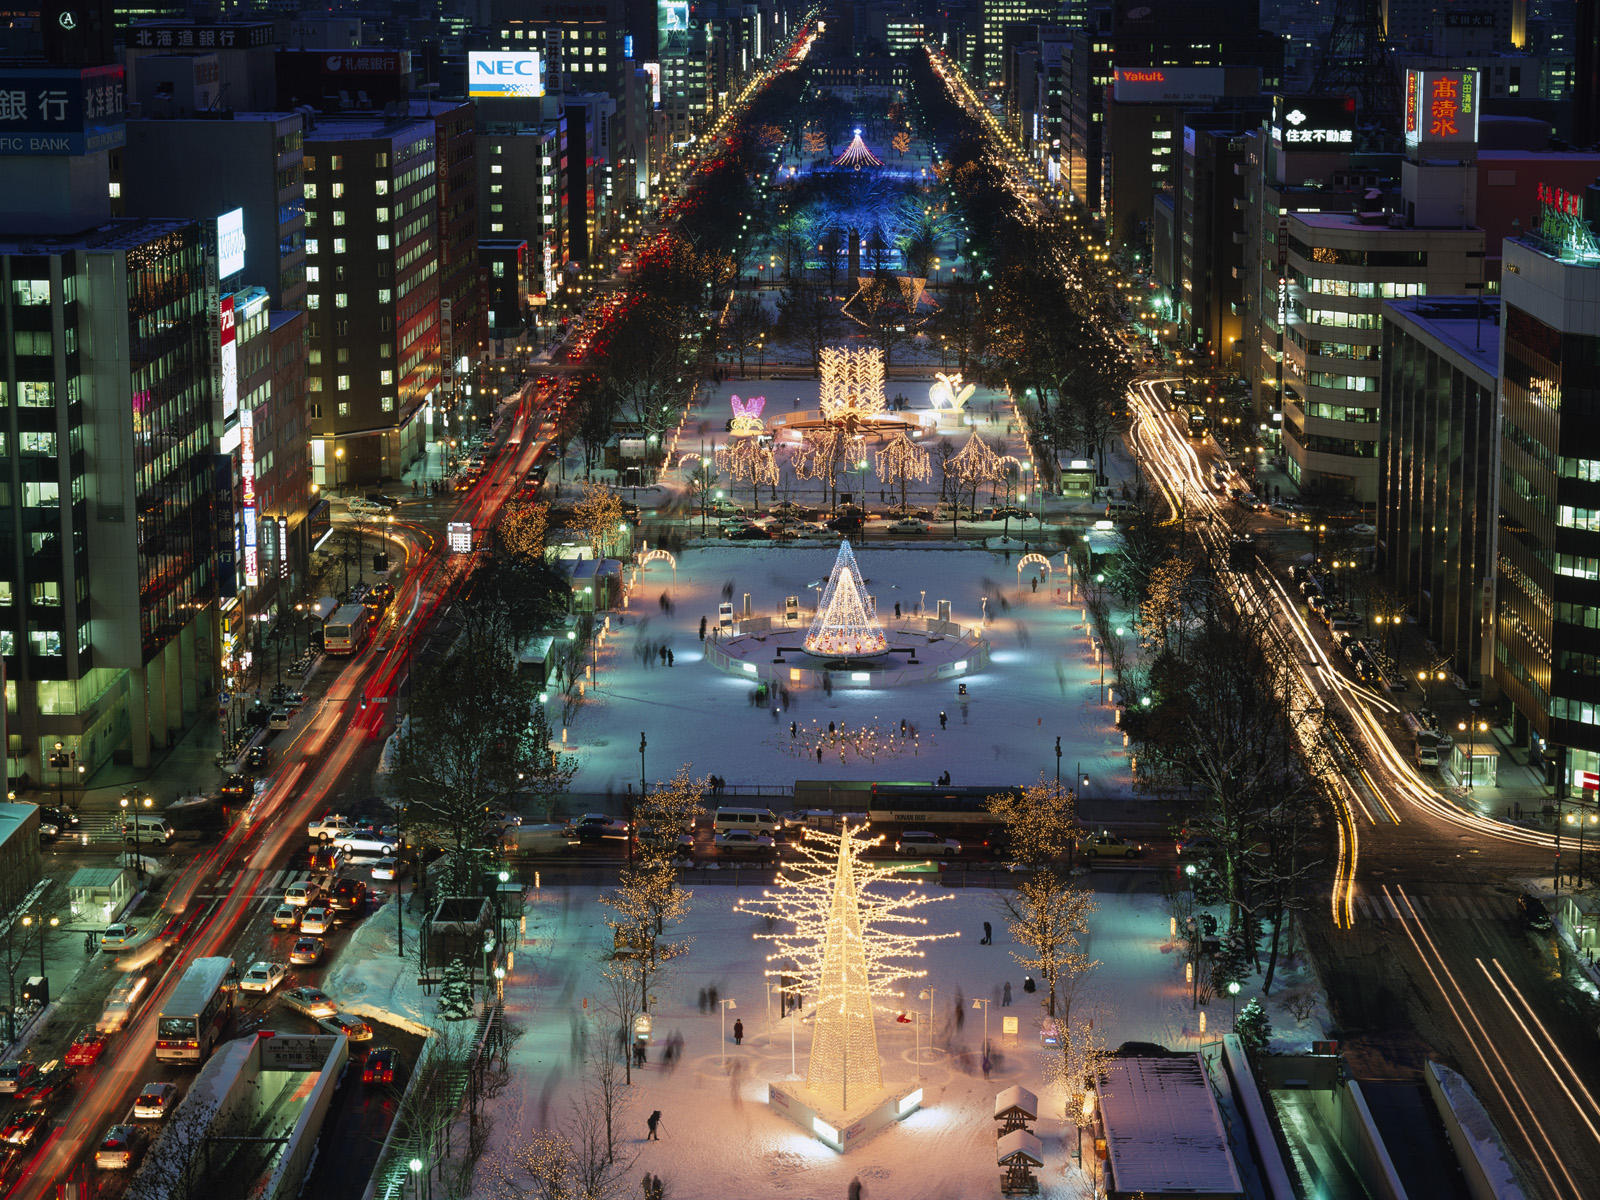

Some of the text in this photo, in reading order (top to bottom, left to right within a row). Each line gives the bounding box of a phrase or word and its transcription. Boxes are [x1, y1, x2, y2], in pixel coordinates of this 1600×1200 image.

[136, 30, 237, 47] 北海道銀行
[345, 56, 395, 72] 札幌銀行
[476, 60, 533, 76] NEC
[1123, 71, 1165, 82] Yakult
[1461, 74, 1473, 113] 秋田清酒
[1285, 129, 1353, 143] 住友不動産
[30, 138, 70, 151] BANK
[221, 308, 235, 332] アコム
[217, 488, 233, 564] 北洋銀行
